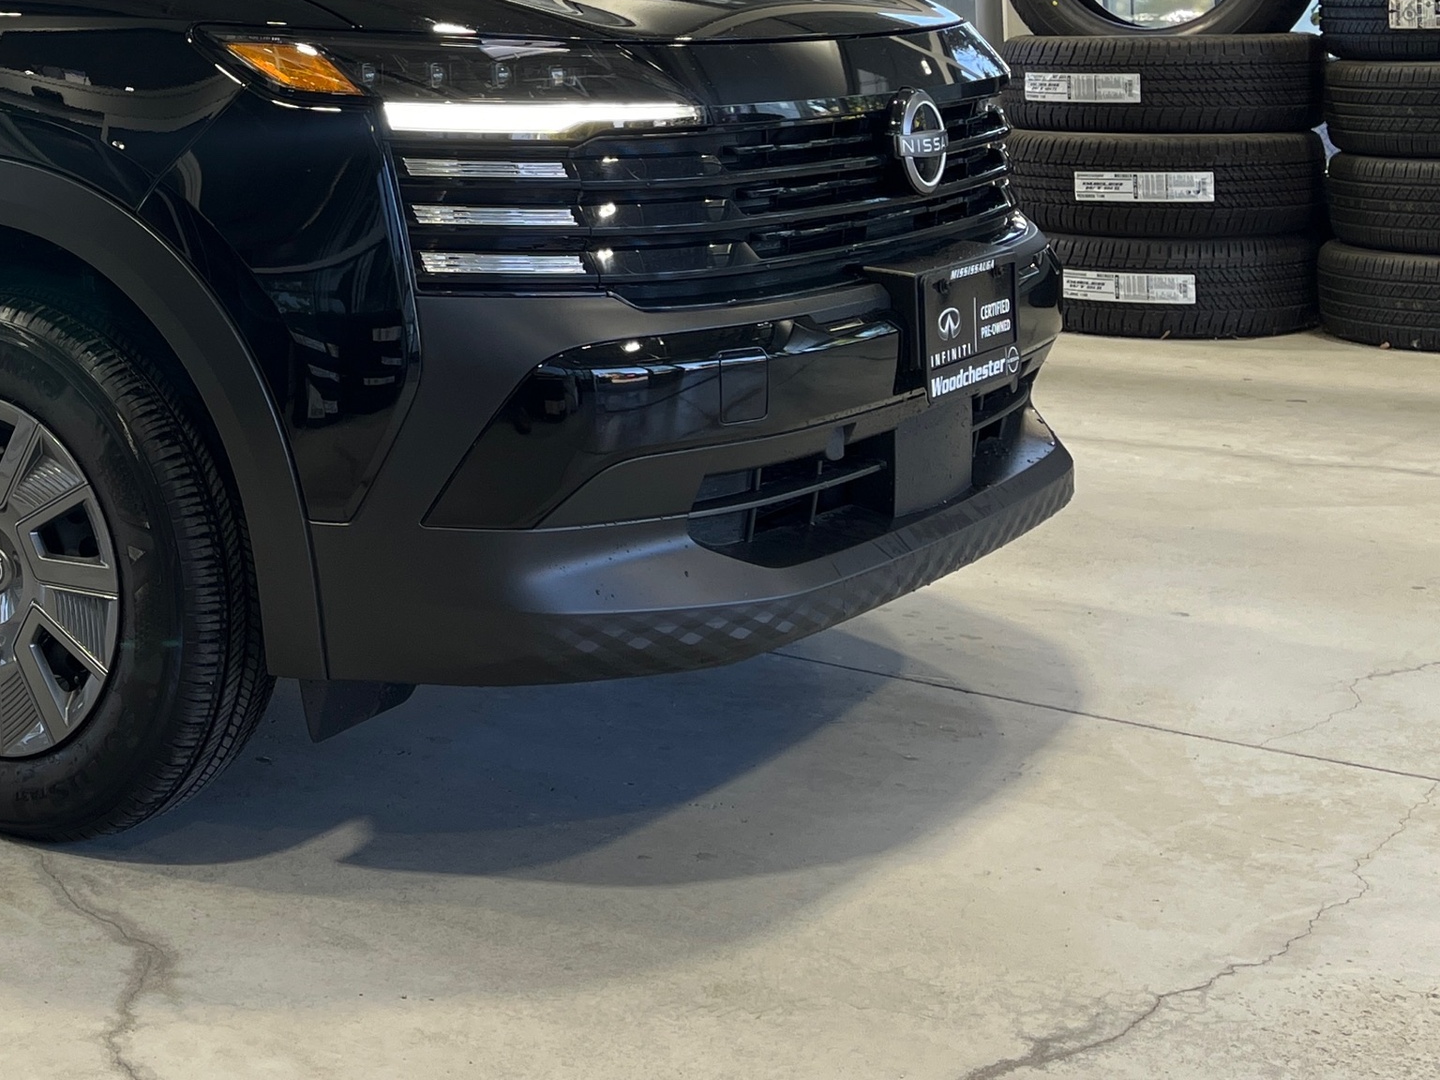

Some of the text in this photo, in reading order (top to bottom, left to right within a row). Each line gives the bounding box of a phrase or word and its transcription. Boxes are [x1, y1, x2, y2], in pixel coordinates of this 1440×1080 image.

[950, 259, 995, 280] MISSISSAUGA
[980, 298, 1010, 320] CERTIFIED
[980, 319, 1011, 338] PRE-OWNED
[930, 343, 971, 368] INFINITI
[931, 357, 1006, 398] Woodchester
